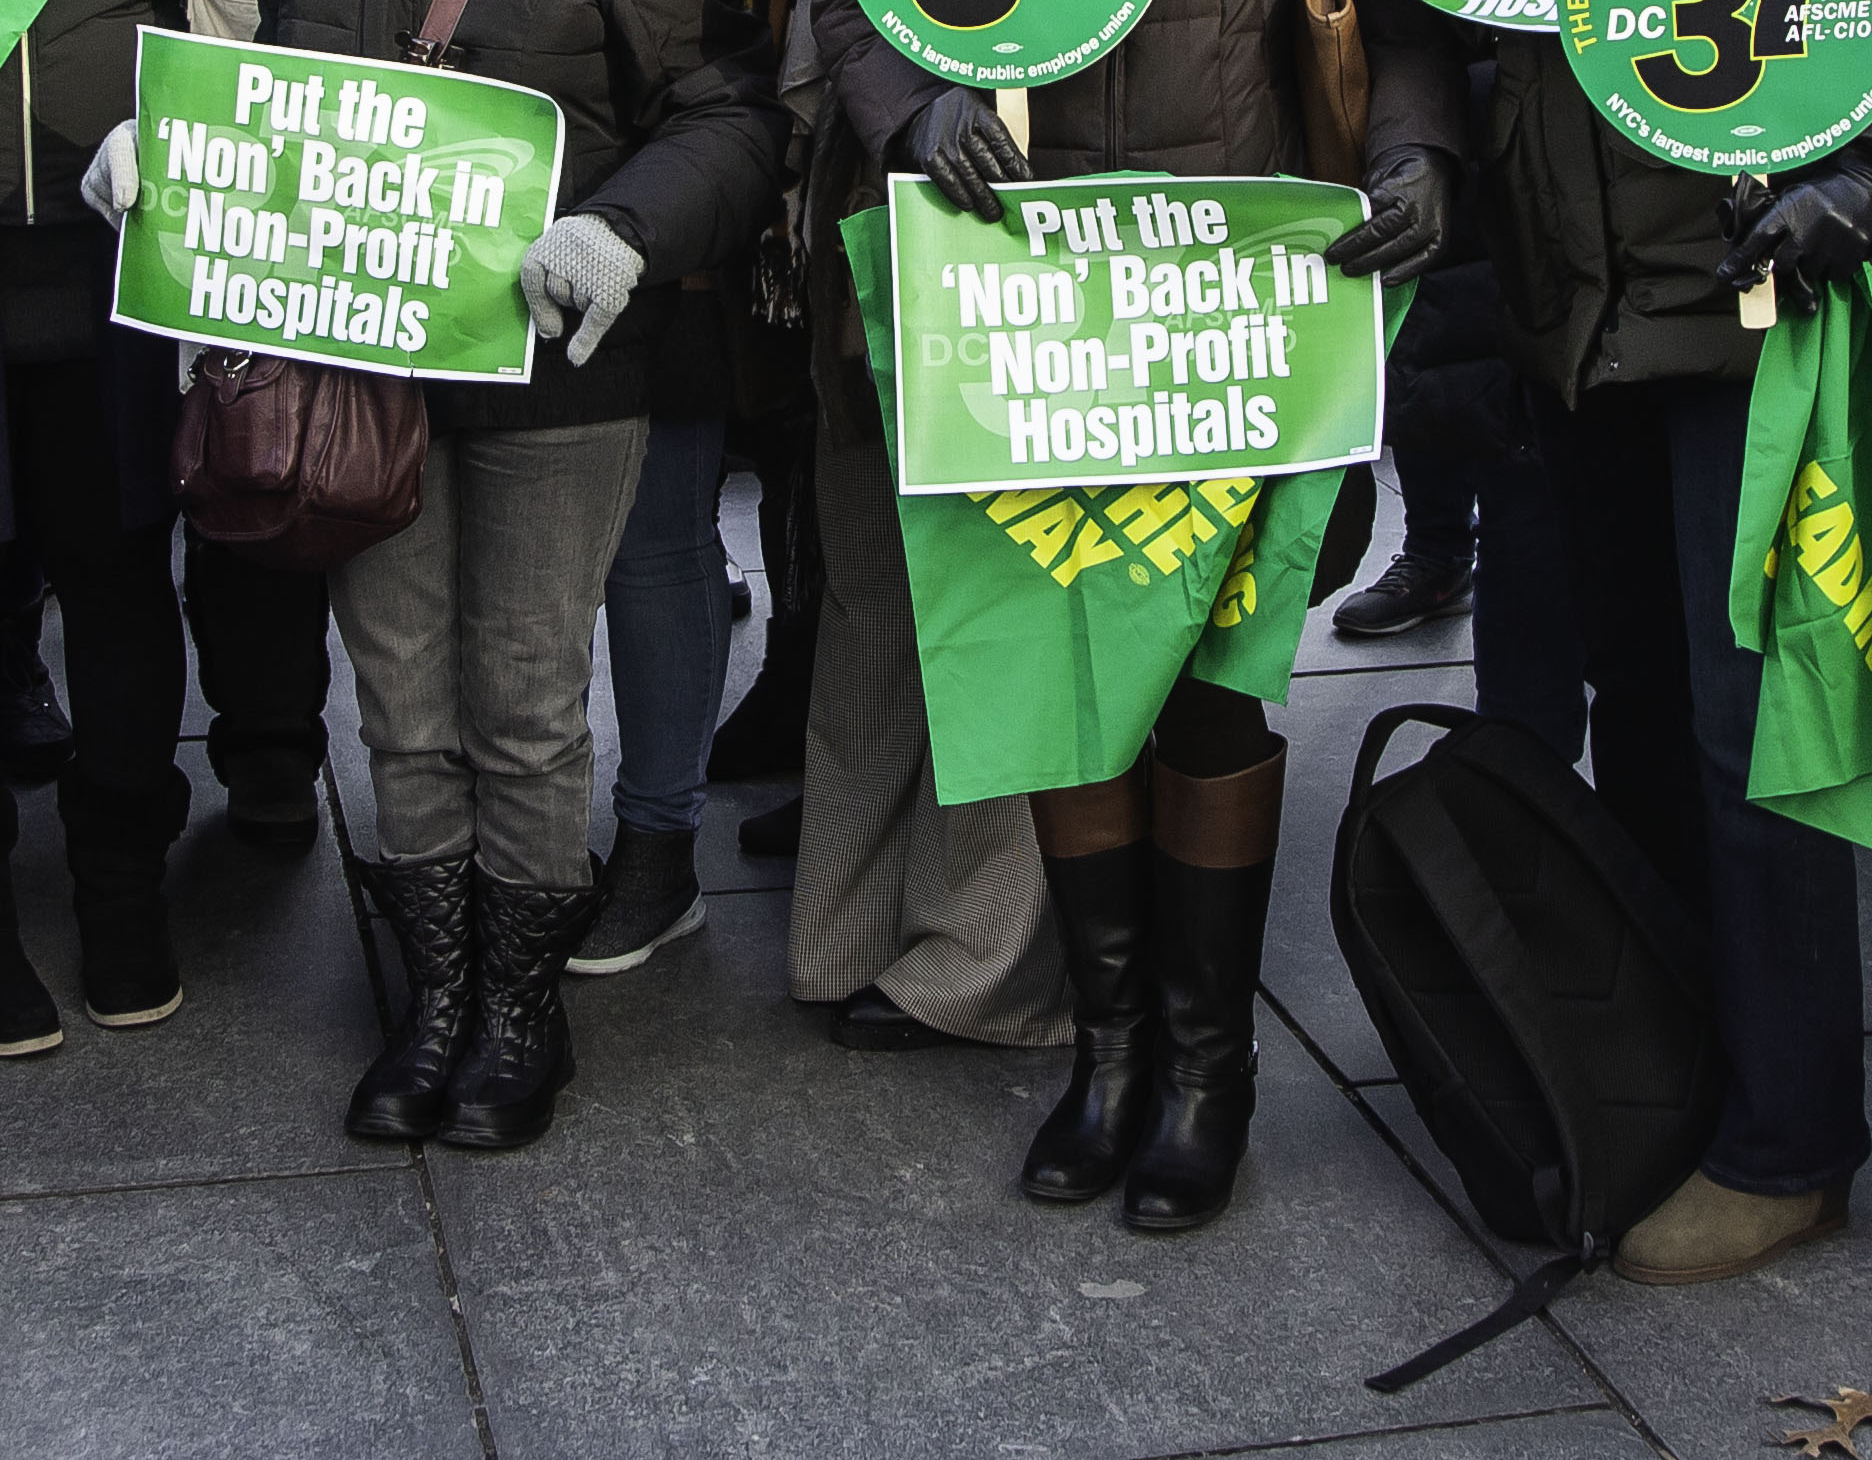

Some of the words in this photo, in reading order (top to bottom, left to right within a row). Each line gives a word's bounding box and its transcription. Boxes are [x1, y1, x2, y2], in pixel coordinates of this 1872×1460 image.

[921, 44, 974, 77] largest
[976, 64, 1025, 81] public
[1028, 39, 1099, 77] employee
[1098, 1, 1136, 45] union
[1606, 5, 1666, 41] DC
[1784, 0, 1871, 22] AFSCME
[234, 62, 326, 137] Put
[337, 79, 428, 149] the
[1651, 128, 1709, 164] largest
[1712, 150, 1768, 168] public
[1771, 121, 1852, 163] employee
[298, 139, 439, 219] Back
[449, 160, 505, 228] in
[183, 187, 455, 290] Non-Profit
[1020, 197, 1125, 257] Put
[1131, 192, 1229, 248] the
[188, 256, 430, 353] Hospitals
[1109, 247, 1260, 321] Back
[1270, 244, 1329, 308] in
[989, 313, 1292, 397] Non-Profit
[1006, 384, 1280, 467] Hospitals
